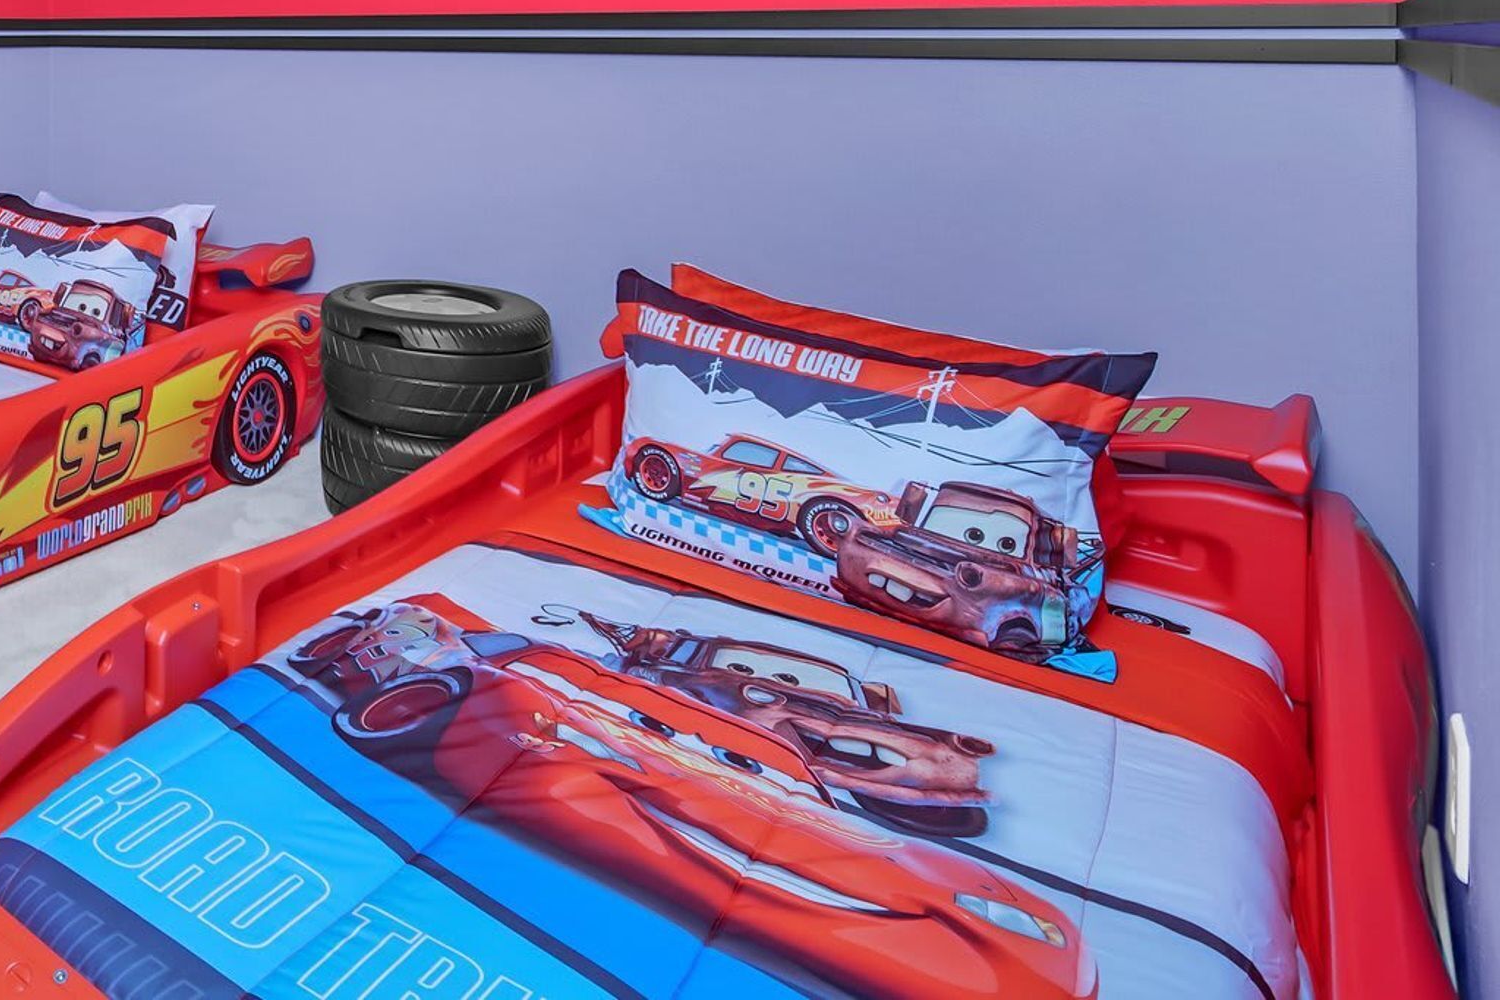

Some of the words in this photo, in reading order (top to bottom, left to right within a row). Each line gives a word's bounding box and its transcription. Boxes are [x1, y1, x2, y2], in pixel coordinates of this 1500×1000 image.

[231, 356, 289, 401] LIGHTYEAR
[638, 305, 682, 342] TAKE
[684, 319, 728, 352] THE
[726, 331, 795, 367] LONG
[796, 347, 862, 383] WAY
[53, 386, 143, 508] 95
[735, 472, 793, 522] 95
[38, 757, 331, 949] ROAD
